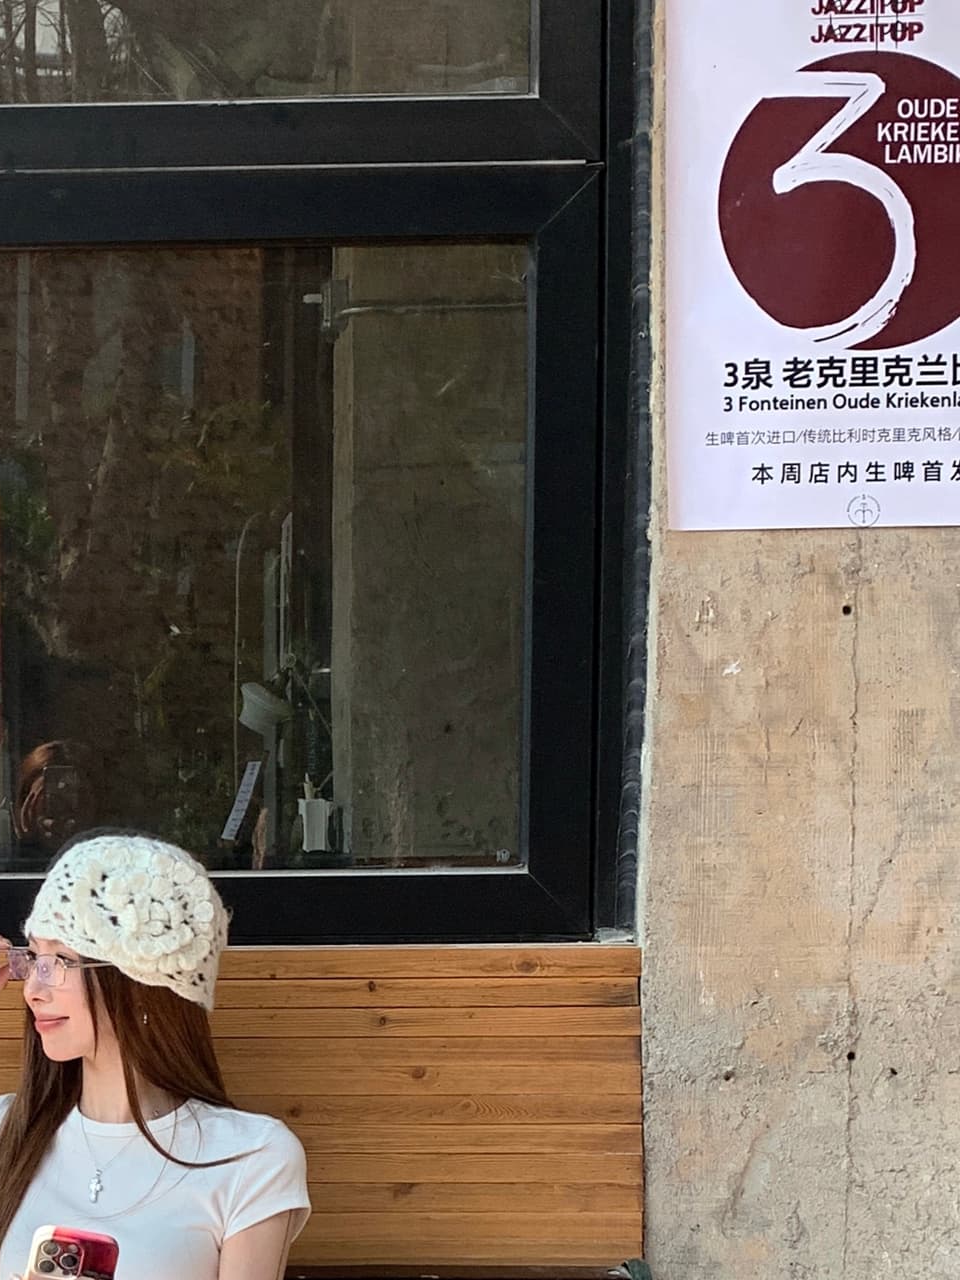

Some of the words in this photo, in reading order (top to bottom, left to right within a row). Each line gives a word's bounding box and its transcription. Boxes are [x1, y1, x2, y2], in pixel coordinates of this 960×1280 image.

[897, 98, 959, 119] OUDE
[877, 122, 960, 142] KRIEKE
[723, 359, 773, 390] 3泉
[723, 396, 733, 412] 3
[738, 394, 828, 412] Fonteinen
[832, 393, 881, 410] Oude
[705, 427, 960, 447] 生啤首次进口/传统比利时克里克风格/
